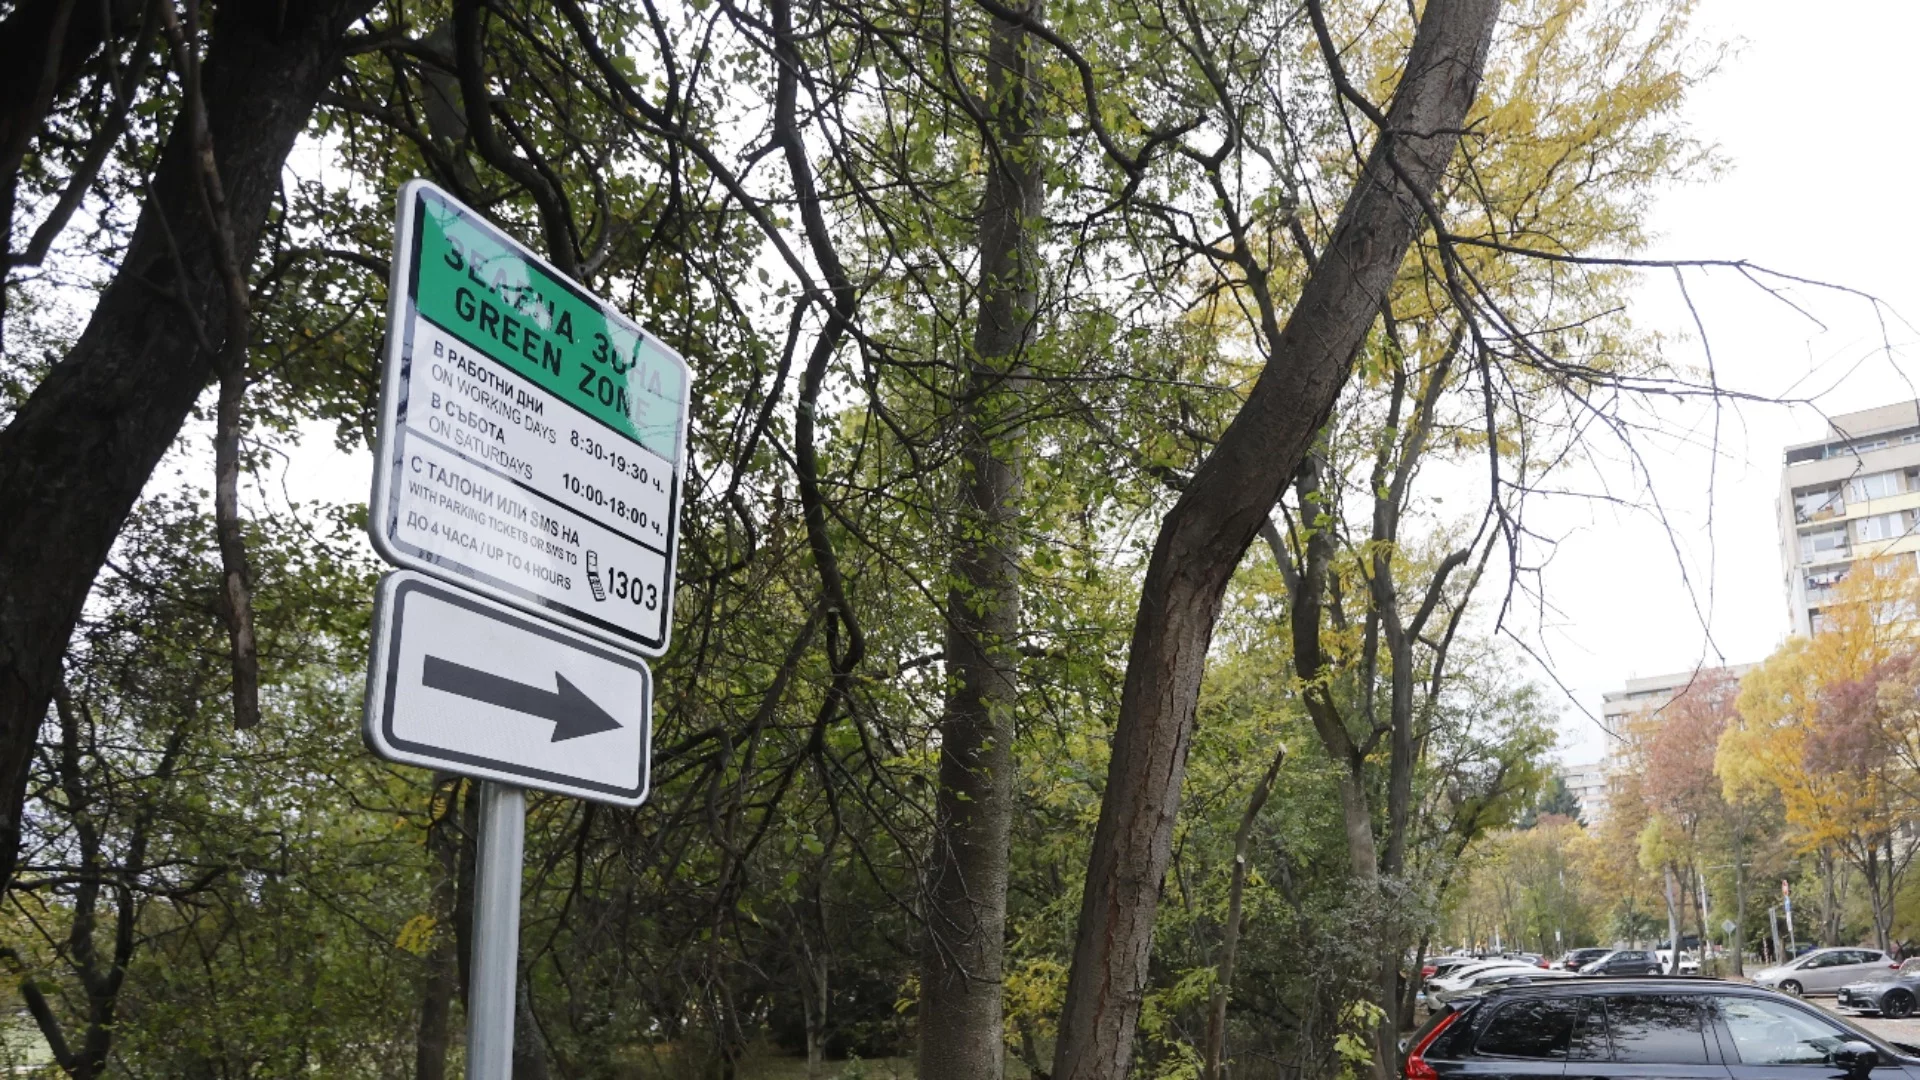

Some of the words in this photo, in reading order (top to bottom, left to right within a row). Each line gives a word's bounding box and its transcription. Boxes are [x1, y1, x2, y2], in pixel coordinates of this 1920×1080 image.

[434, 341, 443, 358] В
[448, 349, 513, 401] РАБОТНИ
[516, 390, 543, 417] ДНИ
[455, 287, 562, 376] GREEN
[579, 363, 649, 427] ZONE
[592, 332, 662, 396] ЗОНА
[431, 393, 441, 409] В
[446, 400, 505, 444] СЪБОТА
[432, 364, 452, 388] ON
[456, 378, 521, 425] WORKING
[524, 416, 557, 444] DAYS
[429, 416, 449, 439] ON
[454, 426, 533, 480] SATURDAYS
[571, 430, 648, 485] 8:30-19:30
[409, 480, 437, 504] WITH
[439, 493, 485, 526] PARKING
[488, 515, 528, 543] TICKETS
[531, 535, 545, 550] OR
[565, 549, 577, 565] TO
[411, 455, 423, 473] С
[427, 462, 494, 507] ТАЛОНИ
[497, 490, 527, 519] ИЛИ
[530, 510, 559, 537] SMS
[561, 524, 580, 547] НА
[563, 473, 647, 528] 10:00-18:00
[407, 510, 429, 532] ДО
[431, 522, 440, 536] 4
[442, 524, 478, 552] ЧАСА
[487, 543, 504, 561] UP
[506, 553, 522, 570] TO
[524, 562, 530, 574] 4
[532, 566, 571, 590] HOURS
[608, 567, 657, 611] 1303
